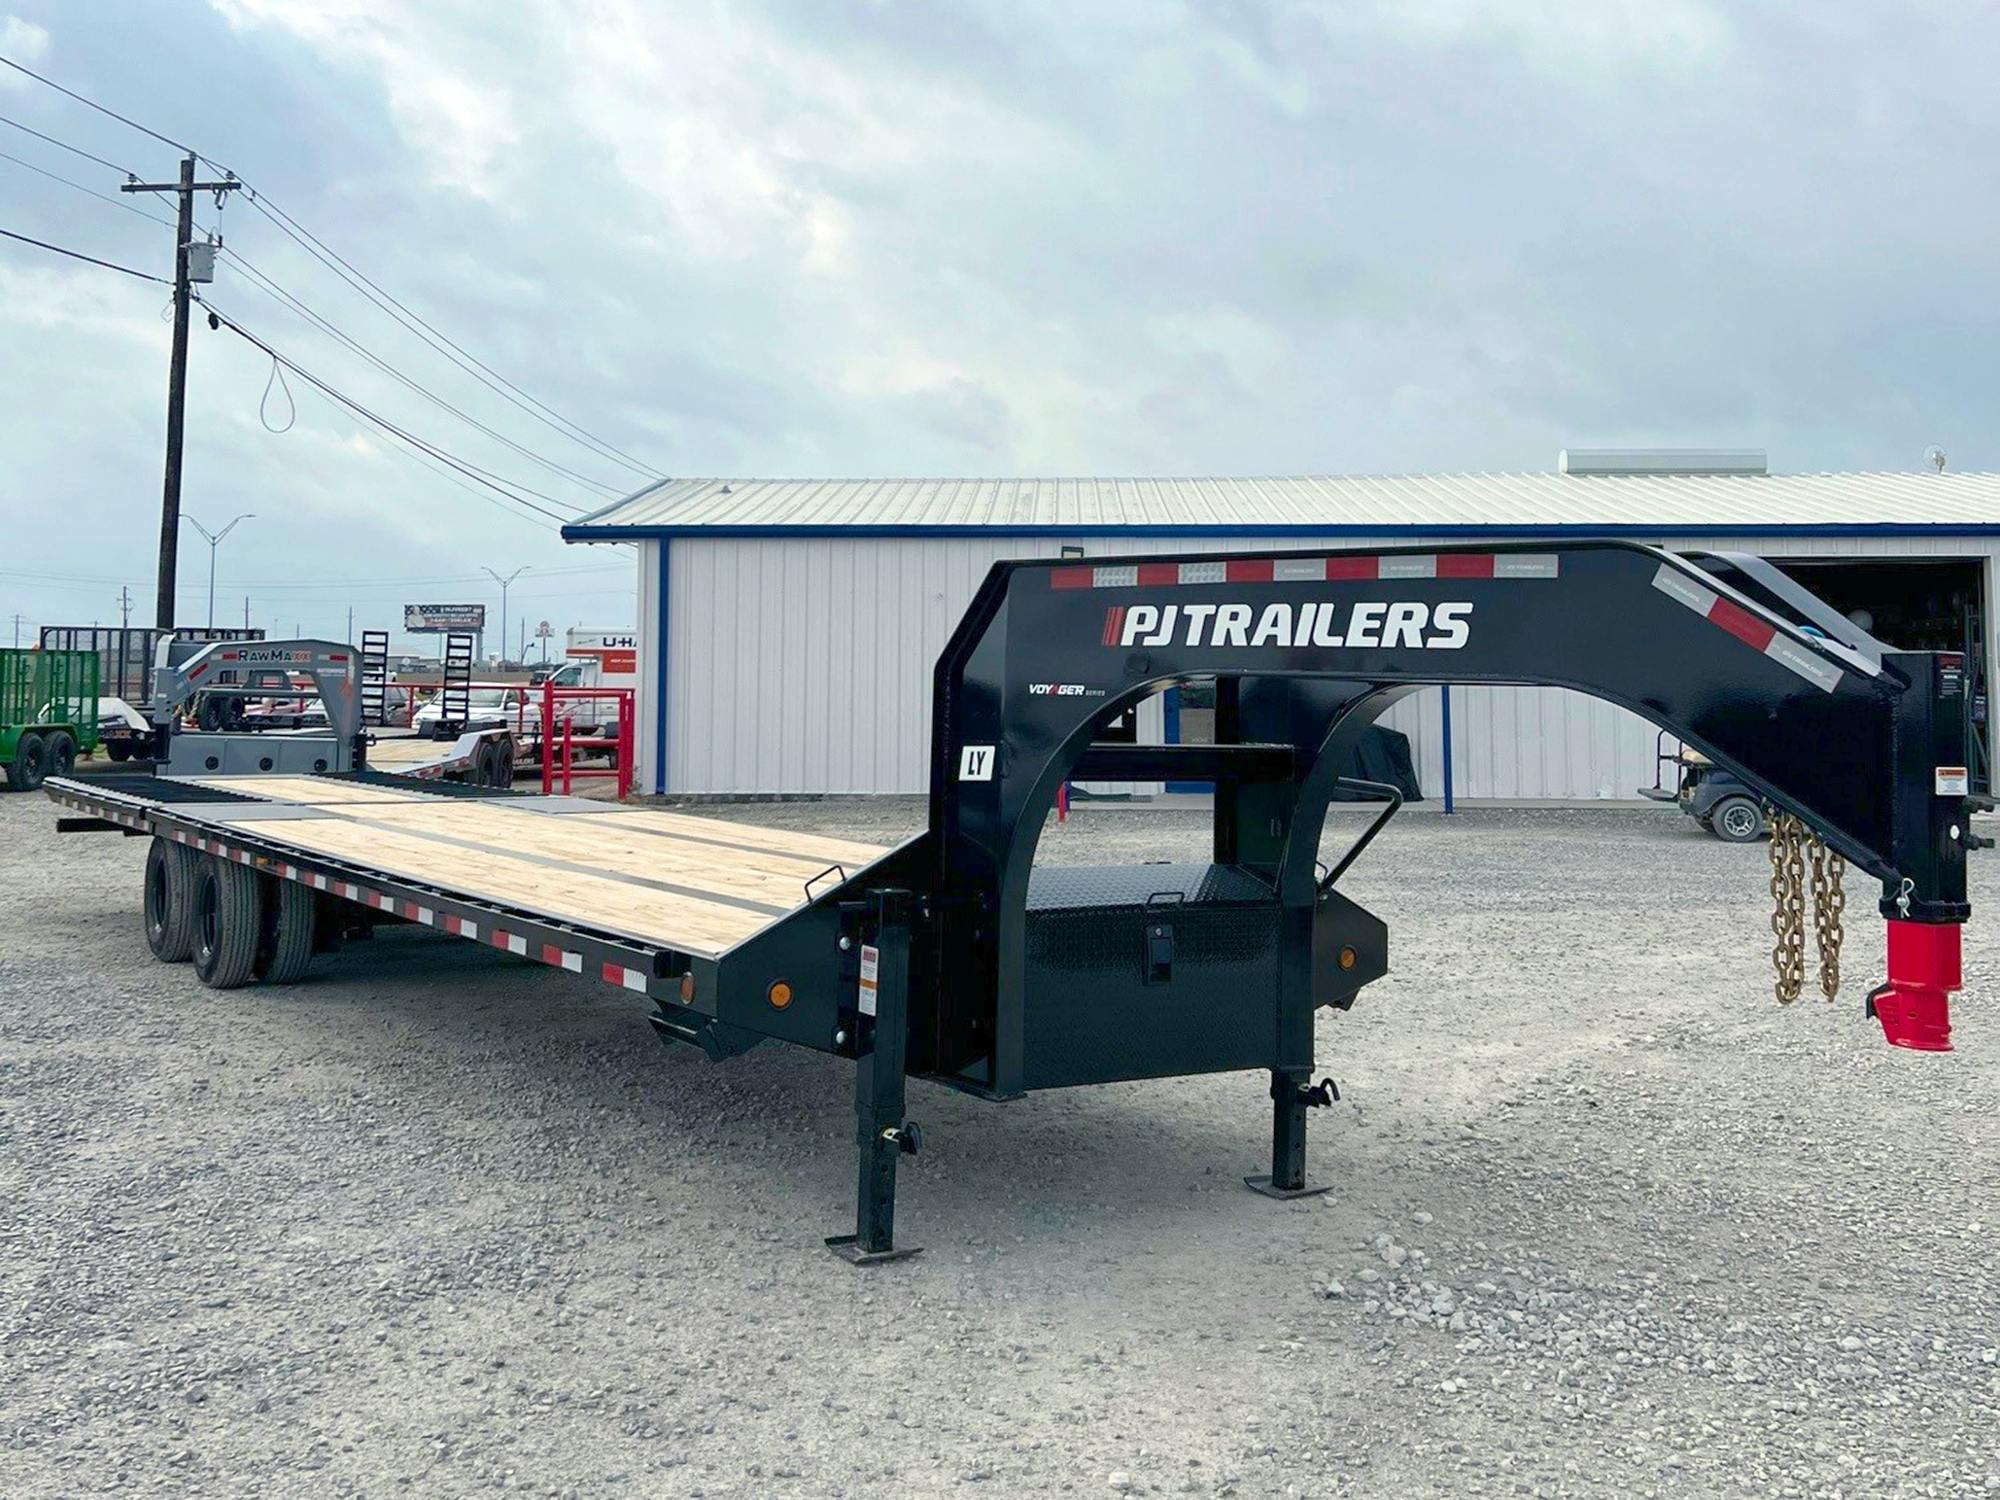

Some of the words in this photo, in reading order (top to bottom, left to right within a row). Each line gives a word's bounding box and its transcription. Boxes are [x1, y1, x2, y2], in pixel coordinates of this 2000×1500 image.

[1120, 604, 1179, 647] PJ
[1182, 602, 1474, 649] TRAILERS
[1029, 682, 1085, 696] VOYAGER
[968, 751, 986, 775] LY
